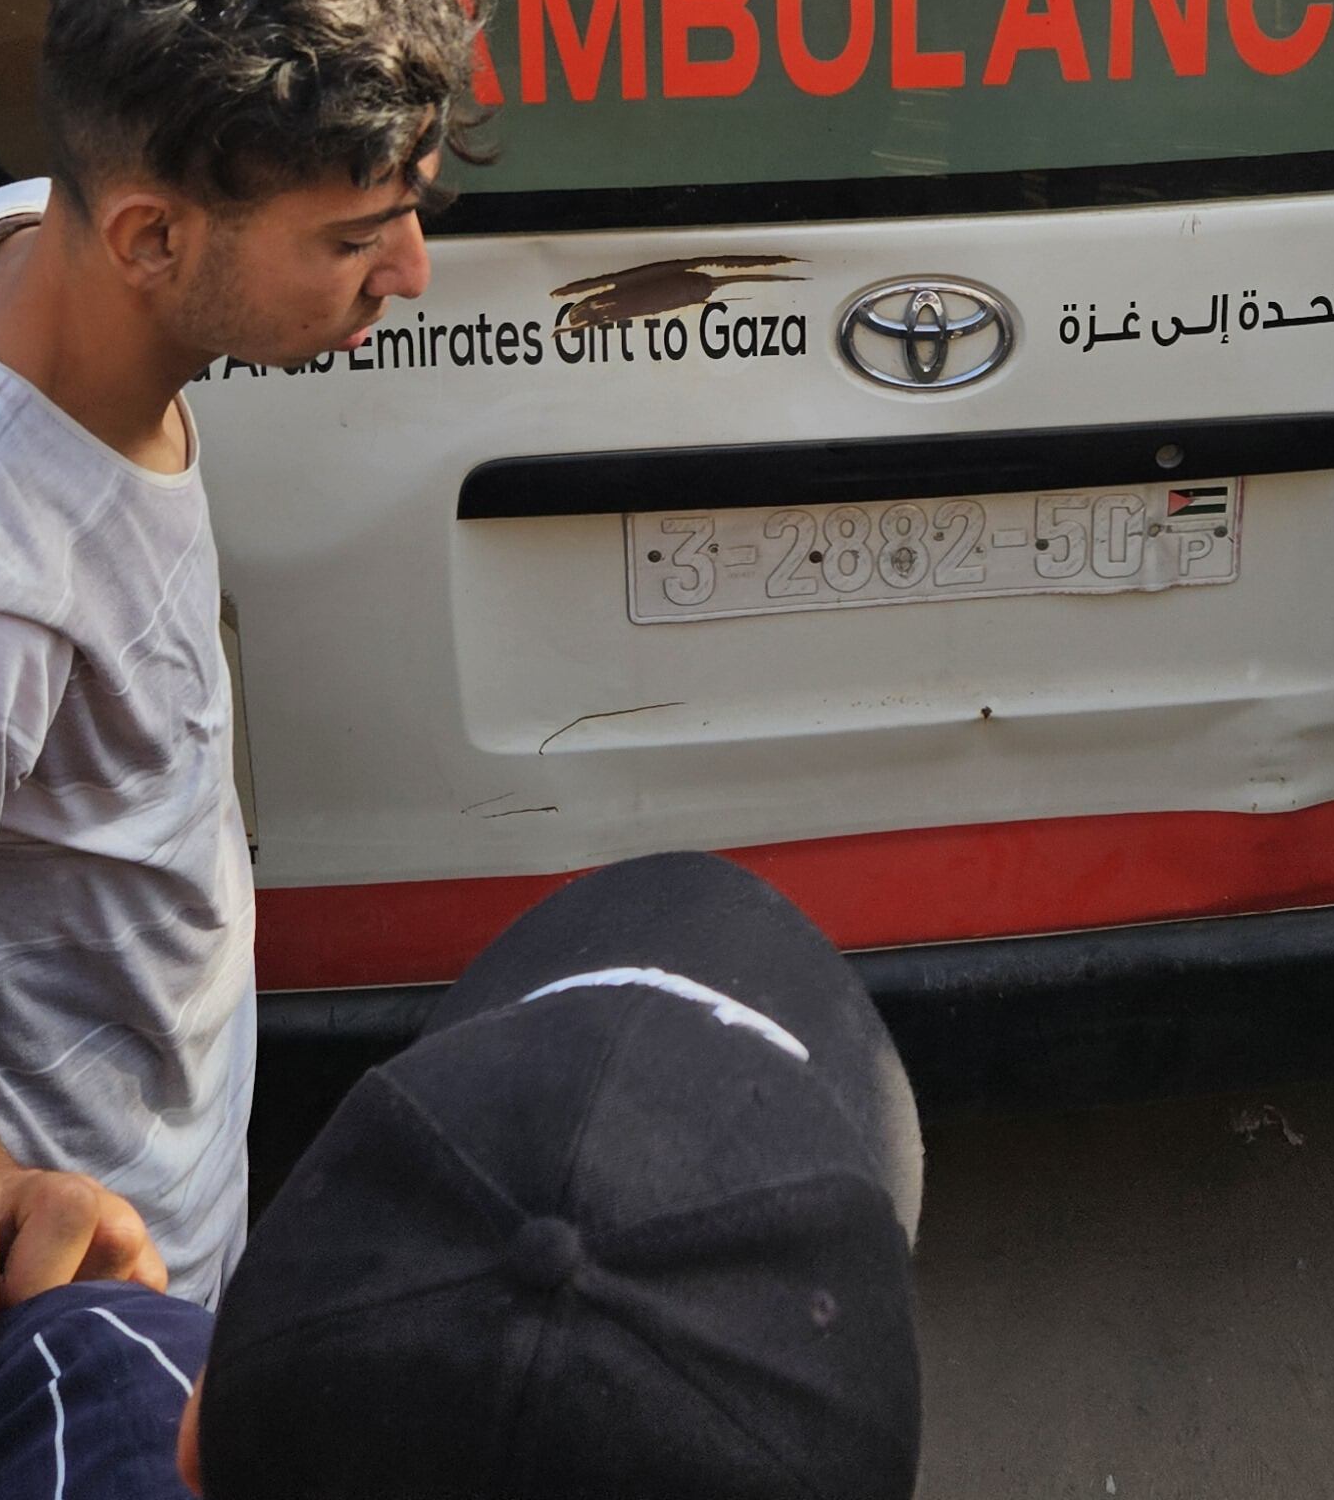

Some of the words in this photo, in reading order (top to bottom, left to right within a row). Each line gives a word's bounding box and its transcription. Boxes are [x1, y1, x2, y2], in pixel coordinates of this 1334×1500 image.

[644, 317, 688, 362] to
[699, 301, 808, 360] Gaza
[1059, 301, 1141, 353] غزة
[1151, 295, 1230, 347] إلى
[1178, 532, 1214, 577] P
